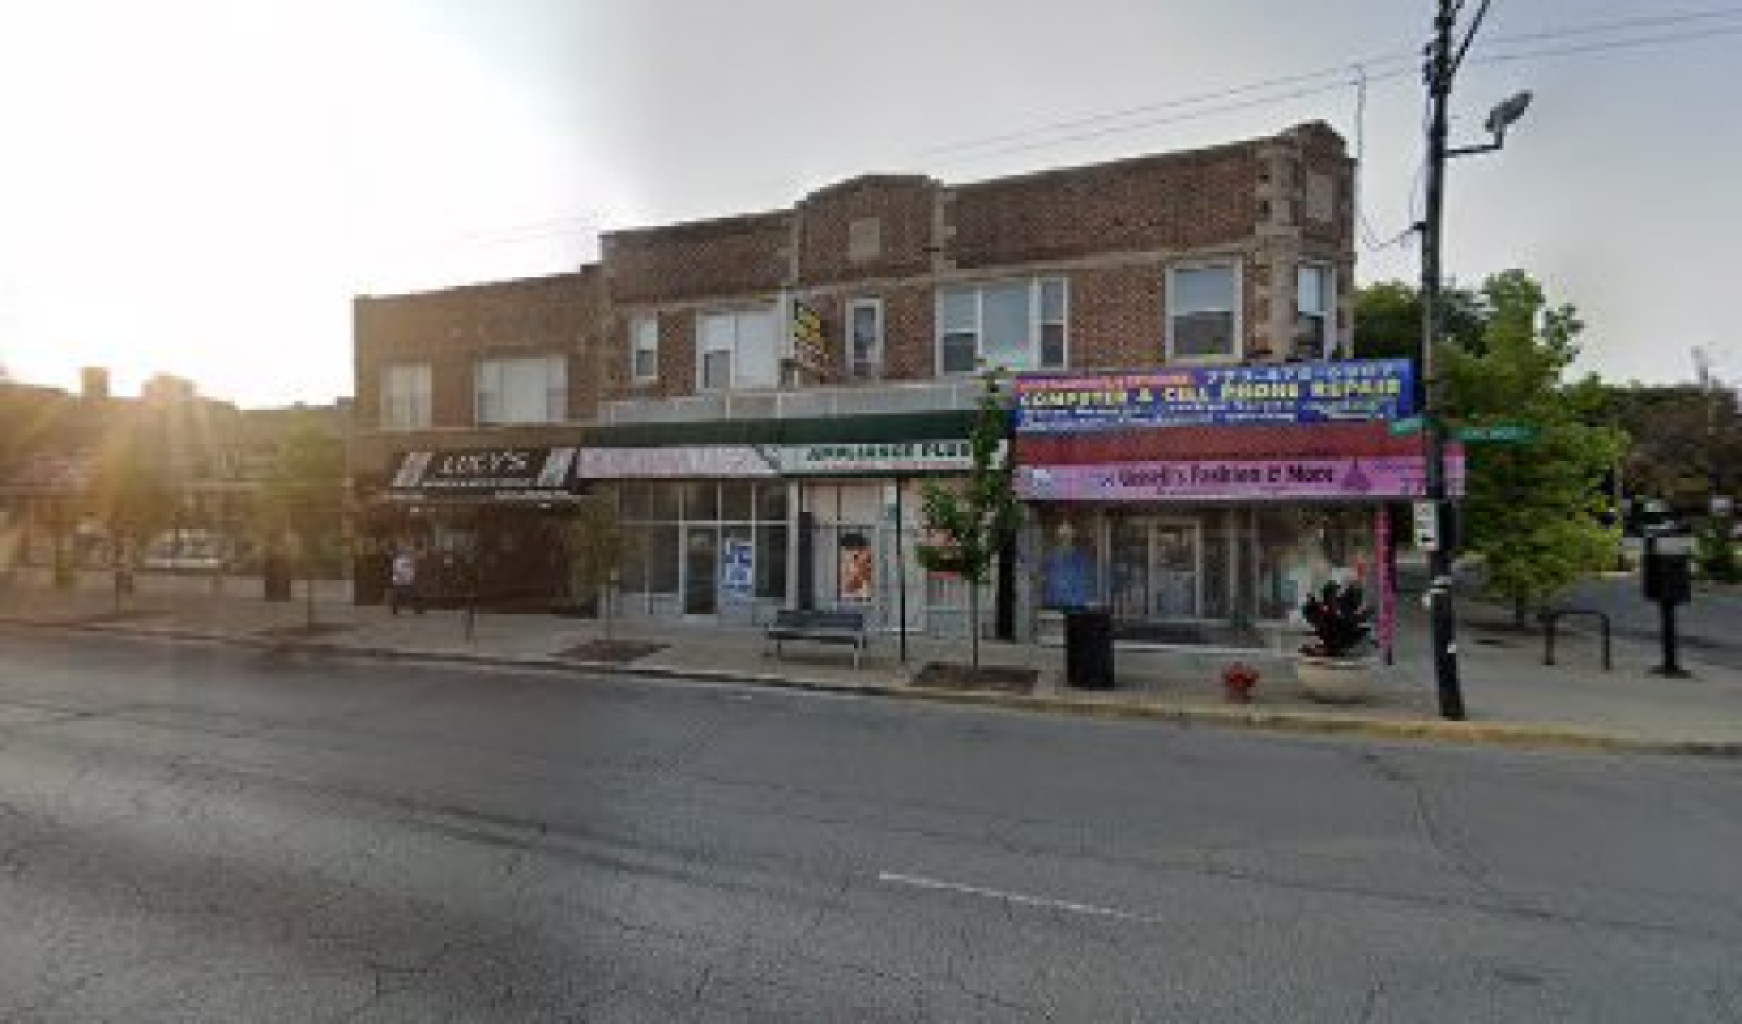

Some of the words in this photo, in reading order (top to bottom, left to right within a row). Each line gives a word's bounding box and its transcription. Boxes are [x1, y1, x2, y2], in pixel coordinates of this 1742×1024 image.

[1019, 391, 1126, 406] COMPUTER
[1161, 386, 1209, 403] CELL
[1220, 383, 1298, 401] PHONE
[1308, 379, 1400, 397] REPAIR
[441, 451, 529, 474] LUCY'S
[805, 445, 914, 461] APPLIANCE
[1189, 464, 1258, 484] Fashion
[1286, 464, 1332, 484] More
